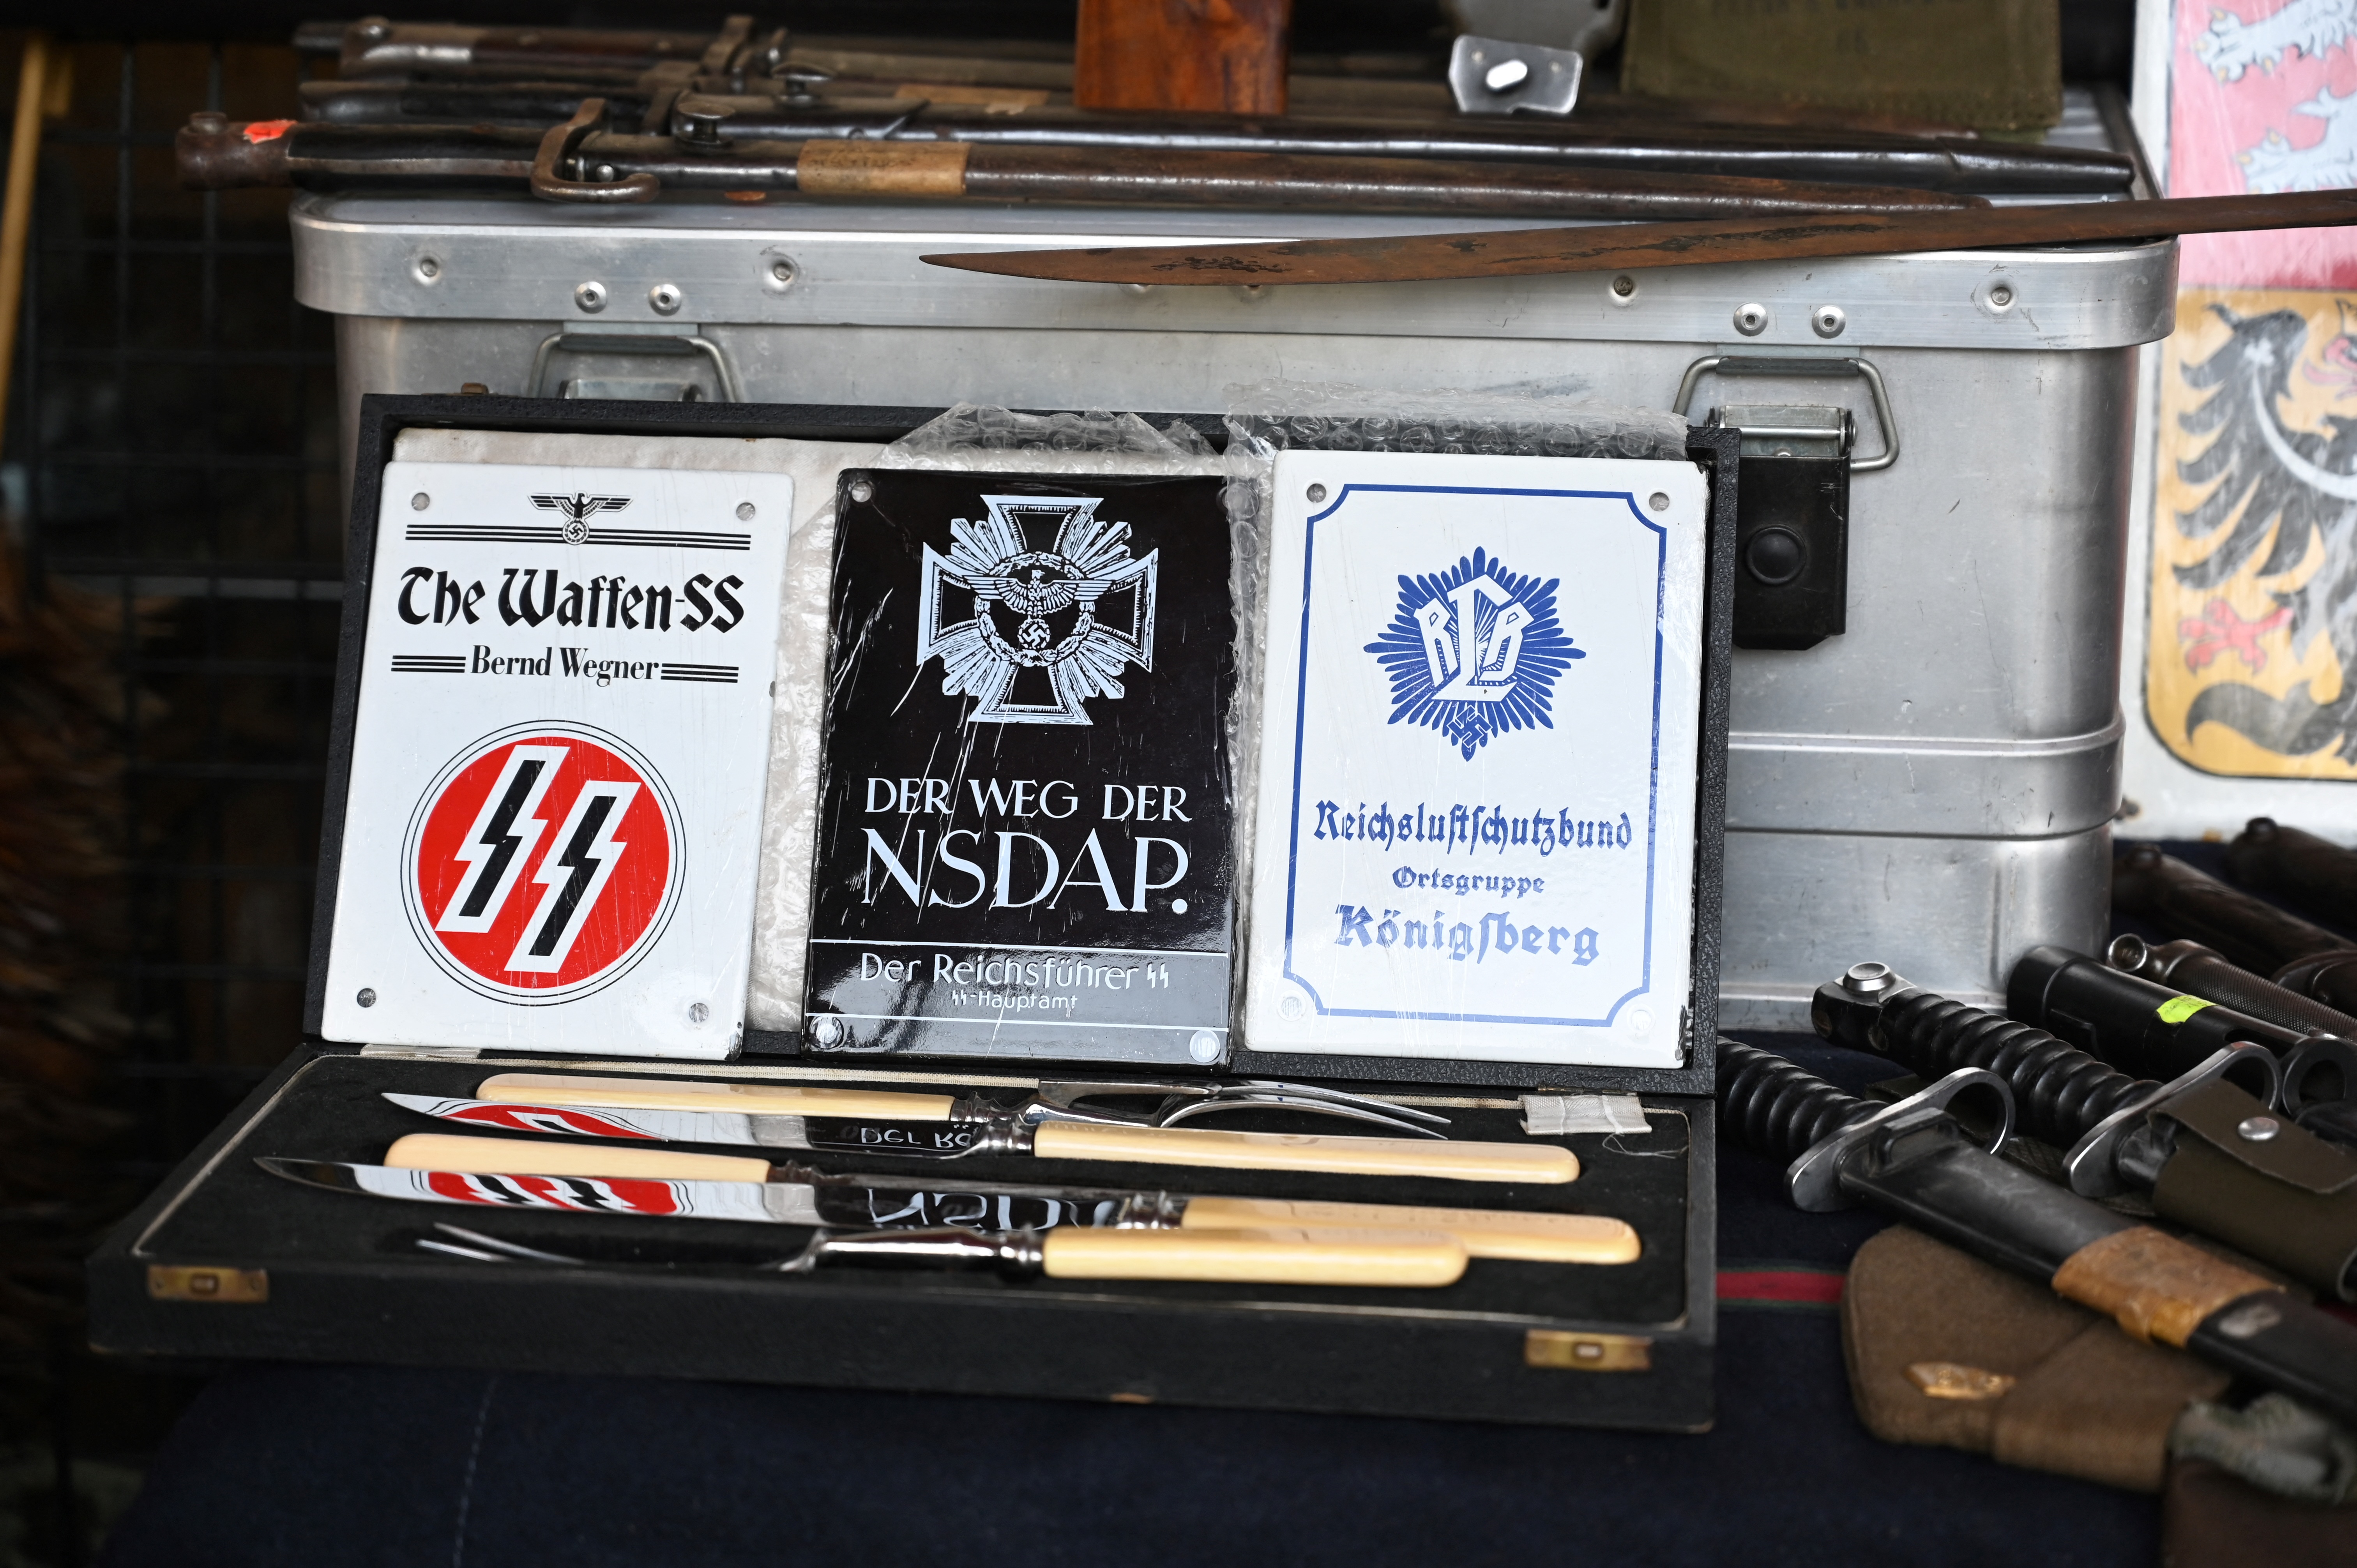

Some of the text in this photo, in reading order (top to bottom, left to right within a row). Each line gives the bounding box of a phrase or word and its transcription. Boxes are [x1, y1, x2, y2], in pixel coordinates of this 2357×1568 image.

[398, 566, 744, 634] The Waffen-SS
[471, 645, 659, 687] Bernd Wegner
[864, 777, 1192, 823] DER WEG DER
[860, 827, 1189, 915] NSDAP.
[1392, 865, 1546, 899] Ortsgruppe
[860, 952, 921, 983] Der
[933, 953, 1139, 991] Reichsführer
